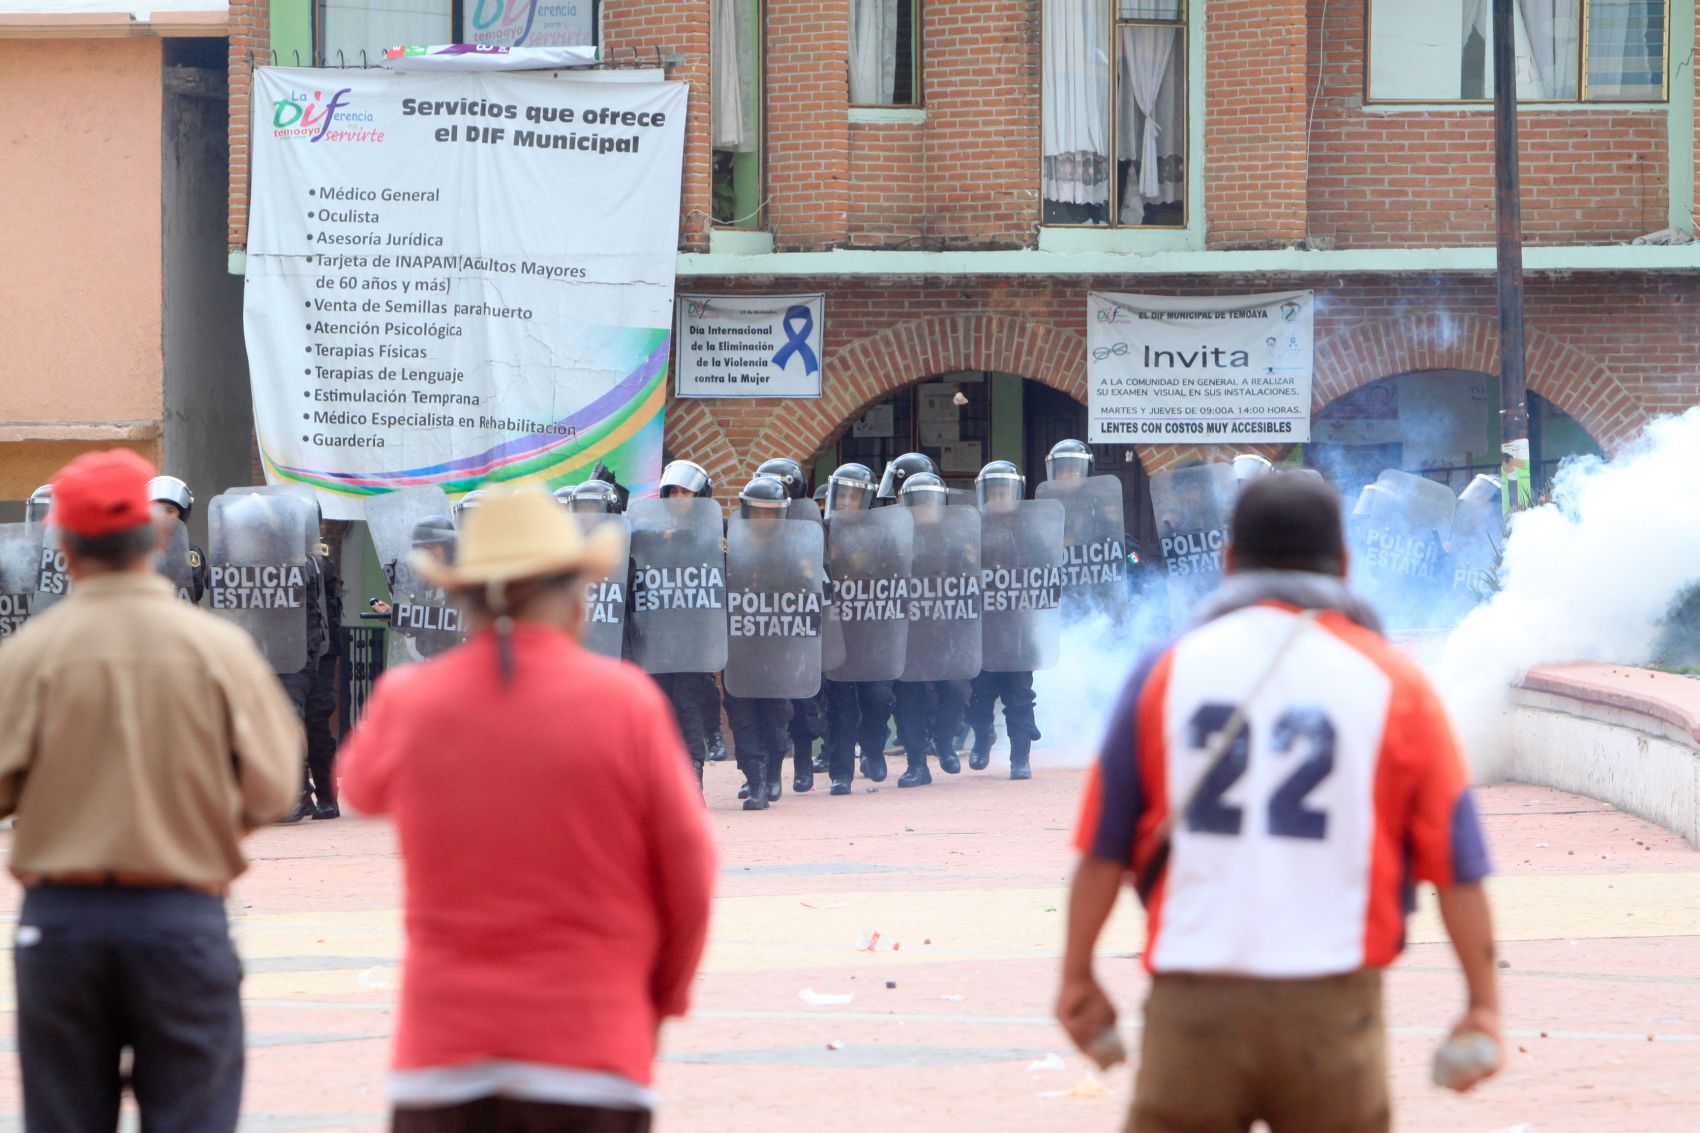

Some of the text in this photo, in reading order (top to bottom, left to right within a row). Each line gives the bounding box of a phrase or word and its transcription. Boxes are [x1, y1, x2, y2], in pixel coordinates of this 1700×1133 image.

[402, 98, 666, 127] Servicios que ofrece
[274, 127, 320, 138] temoaya
[325, 127, 384, 142] servirte
[434, 125, 640, 154] el DIF Municipal
[319, 187, 440, 202] Médico General
[318, 209, 379, 224] Oculista
[316, 231, 443, 247] Asesoría Jurídica
[316, 253, 368, 271] Tarjeta
[372, 255, 391, 269] de
[521, 261, 586, 279] Mayores
[316, 276, 451, 295] de 60 años y más)
[314, 298, 357, 312] Venta
[362, 299, 381, 312] de
[385, 299, 447, 314] Semillas
[1151, 311, 1164, 320] DIF
[1167, 311, 1213, 320] MUNICIPAL
[1215, 311, 1226, 319] DE
[314, 320, 462, 339] Atención Psicológica
[708, 325, 773, 335] Internacional
[315, 343, 428, 360] Terapias Físicas
[691, 341, 774, 352] de la Eliminación
[696, 357, 768, 367] de la Violencia
[1143, 345, 1249, 368] Invita
[315, 366, 464, 385] Terapias de Lenguaje
[694, 373, 770, 385] contra la Mujer
[1101, 378, 1108, 386] A
[1110, 378, 1123, 386] LA
[1125, 378, 1181, 386] COMUNIDAD
[1182, 378, 1195, 386] EN
[1197, 378, 1238, 386] GENERAL
[1251, 377, 1295, 385] REALIZAR
[314, 388, 480, 407] Estimulación Temprana
[1096, 388, 1109, 397] SU
[1111, 388, 1148, 396] EXAMEN
[1153, 388, 1186, 396] VISUAL
[1189, 388, 1201, 396] EN
[1204, 388, 1222, 396] SUS
[314, 411, 367, 425] Médico
[372, 412, 454, 428] Especialista
[459, 416, 475, 428] en
[1100, 407, 1138, 415] MARTES
[1149, 407, 1183, 415] JUEVES
[1238, 406, 1265, 414] 14:00
[1101, 421, 1292, 434] LENTES CON COSTOS MUY ACCESIBLES
[313, 433, 385, 448] Guardería
[1161, 529, 1228, 557] POLICI
[210, 565, 304, 588] POLICIA
[632, 566, 724, 591] POLICIA
[981, 567, 1061, 589] POLICIA
[213, 587, 301, 609] ESTATAL
[635, 588, 722, 612] ESTATAL
[728, 592, 820, 614] POLICIA
[983, 588, 1058, 611] ESTATAL
[397, 603, 467, 632] POLICI
[730, 615, 817, 637] ESTATAL
[1185, 701, 1336, 841] 22
